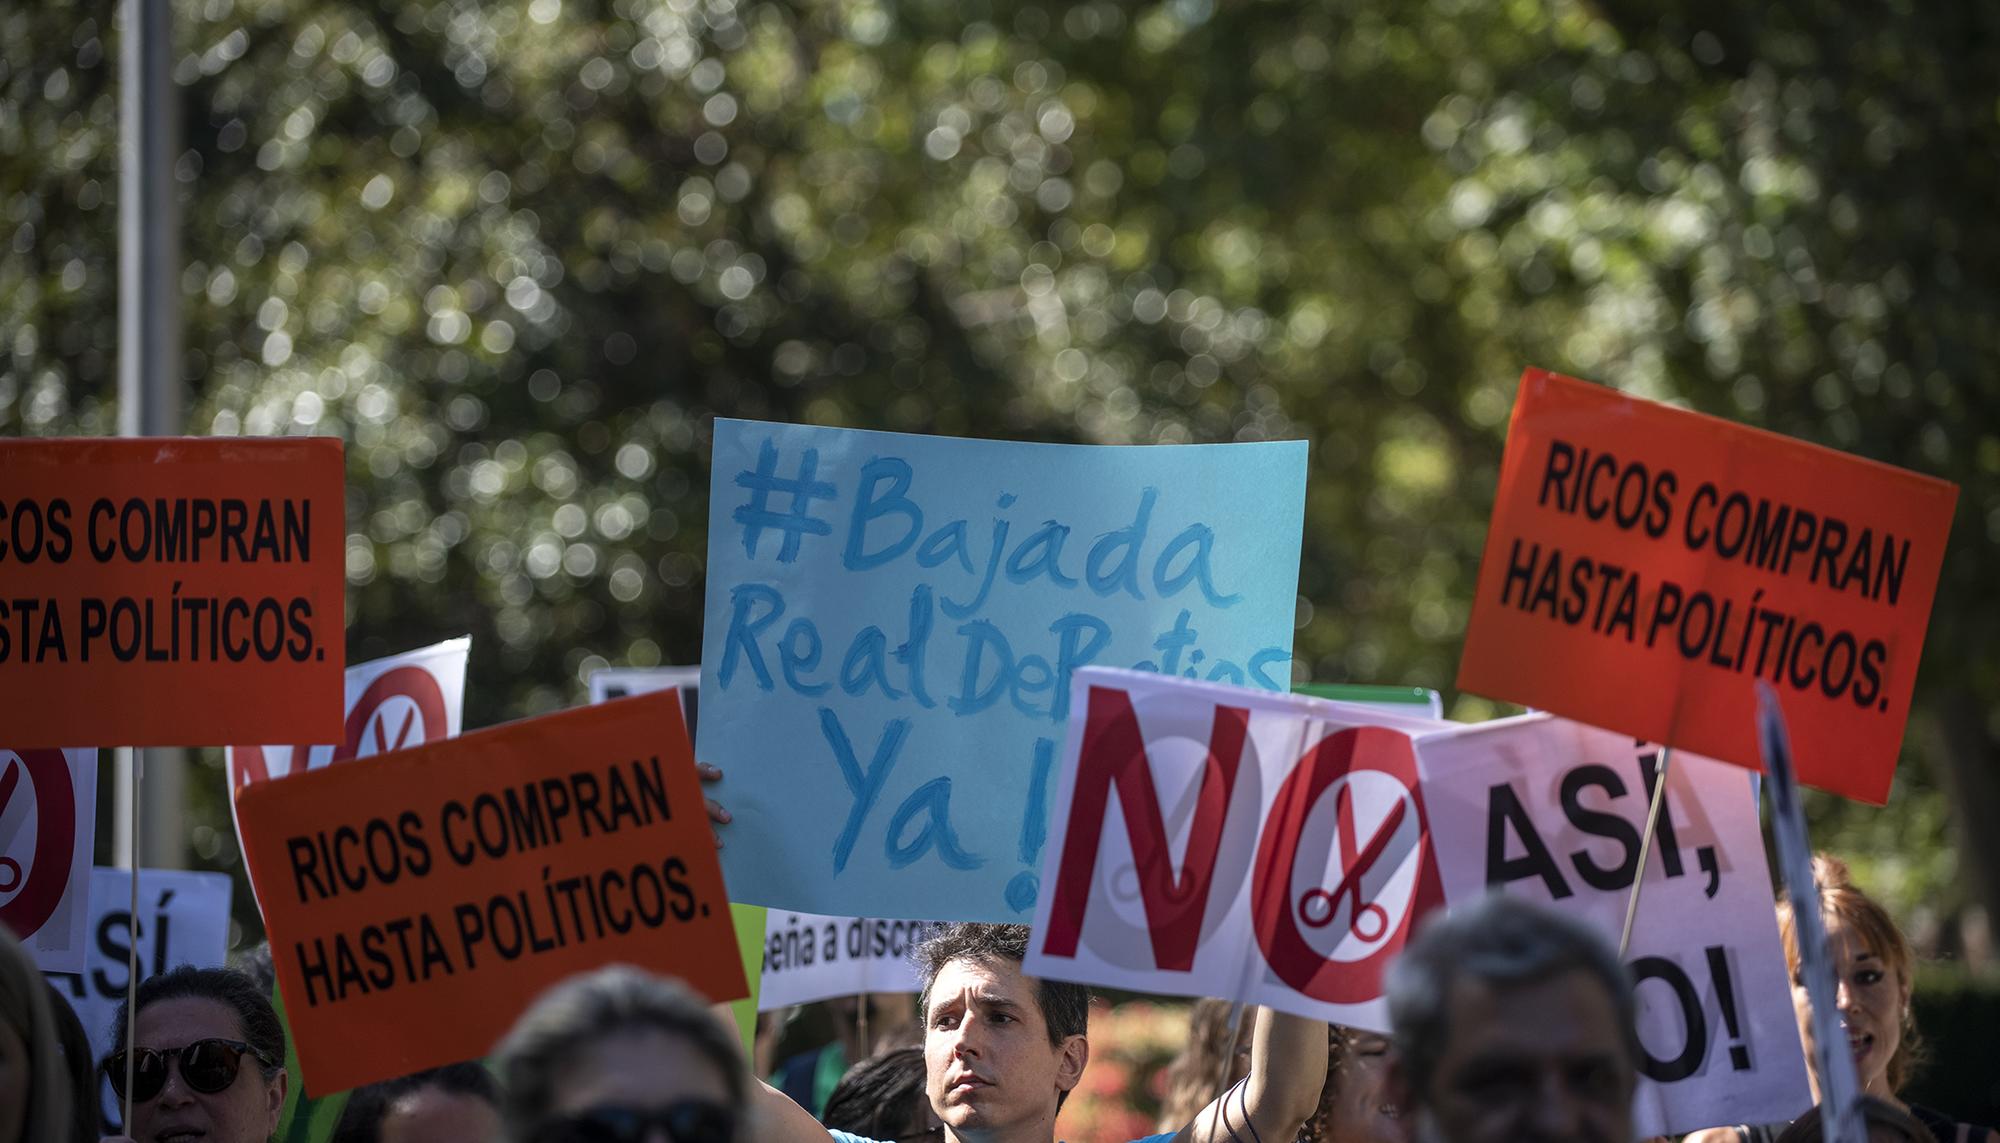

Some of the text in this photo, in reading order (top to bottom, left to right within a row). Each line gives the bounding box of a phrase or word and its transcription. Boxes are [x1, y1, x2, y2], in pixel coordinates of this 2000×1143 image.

[88, 497, 312, 564] COMPRAN
[735, 436, 1242, 619] #Bajada
[1538, 440, 1911, 607] RICOS COMPRAN
[80, 581, 325, 663] POLÍTICOS.
[1501, 538, 1890, 713] HASTA POLÍTICOS.
[287, 755, 672, 904] RICOS COMPRAN
[43, 889, 175, 998] SÍ
[294, 856, 710, 1008] HASTA POLÍTICOS.
[823, 921, 838, 962] a
